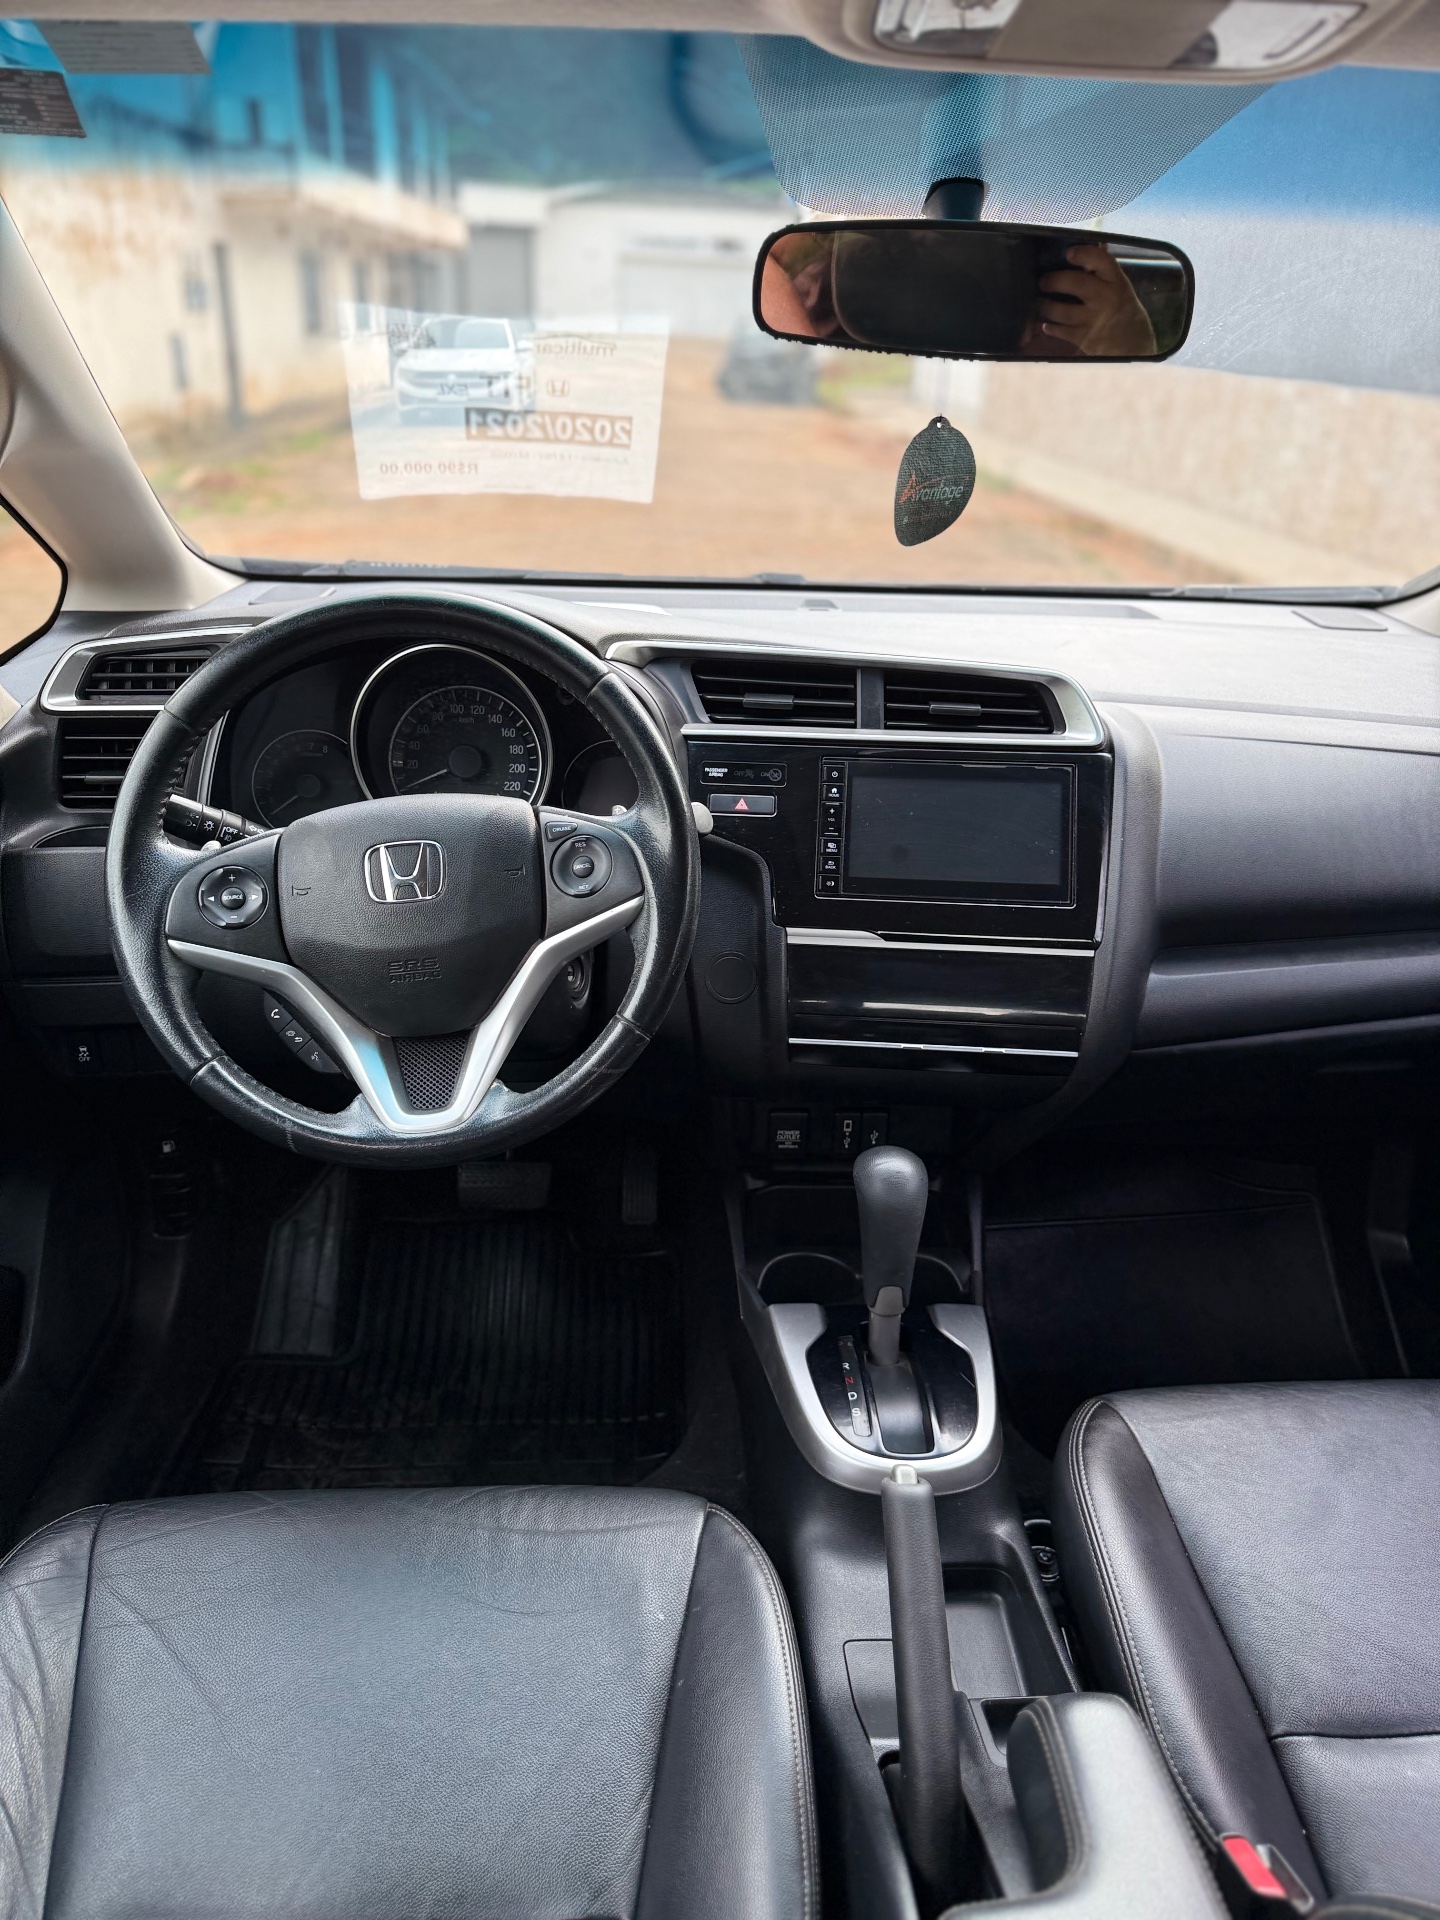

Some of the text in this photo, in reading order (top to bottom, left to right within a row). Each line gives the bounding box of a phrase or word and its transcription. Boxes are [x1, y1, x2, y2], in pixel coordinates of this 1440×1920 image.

[449, 704, 465, 714] 100
[470, 705, 485, 715] 120
[488, 714, 503, 724] 140
[417, 724, 430, 734] 60
[501, 728, 516, 737] 160
[408, 741, 421, 750] 40
[509, 745, 524, 754] 180
[407, 760, 419, 769] 20
[509, 764, 526, 773] 200
[503, 781, 521, 791] 220
[225, 827, 239, 835] OFF
[847, 1392, 858, 1400] D
[851, 1407, 861, 1416] S
